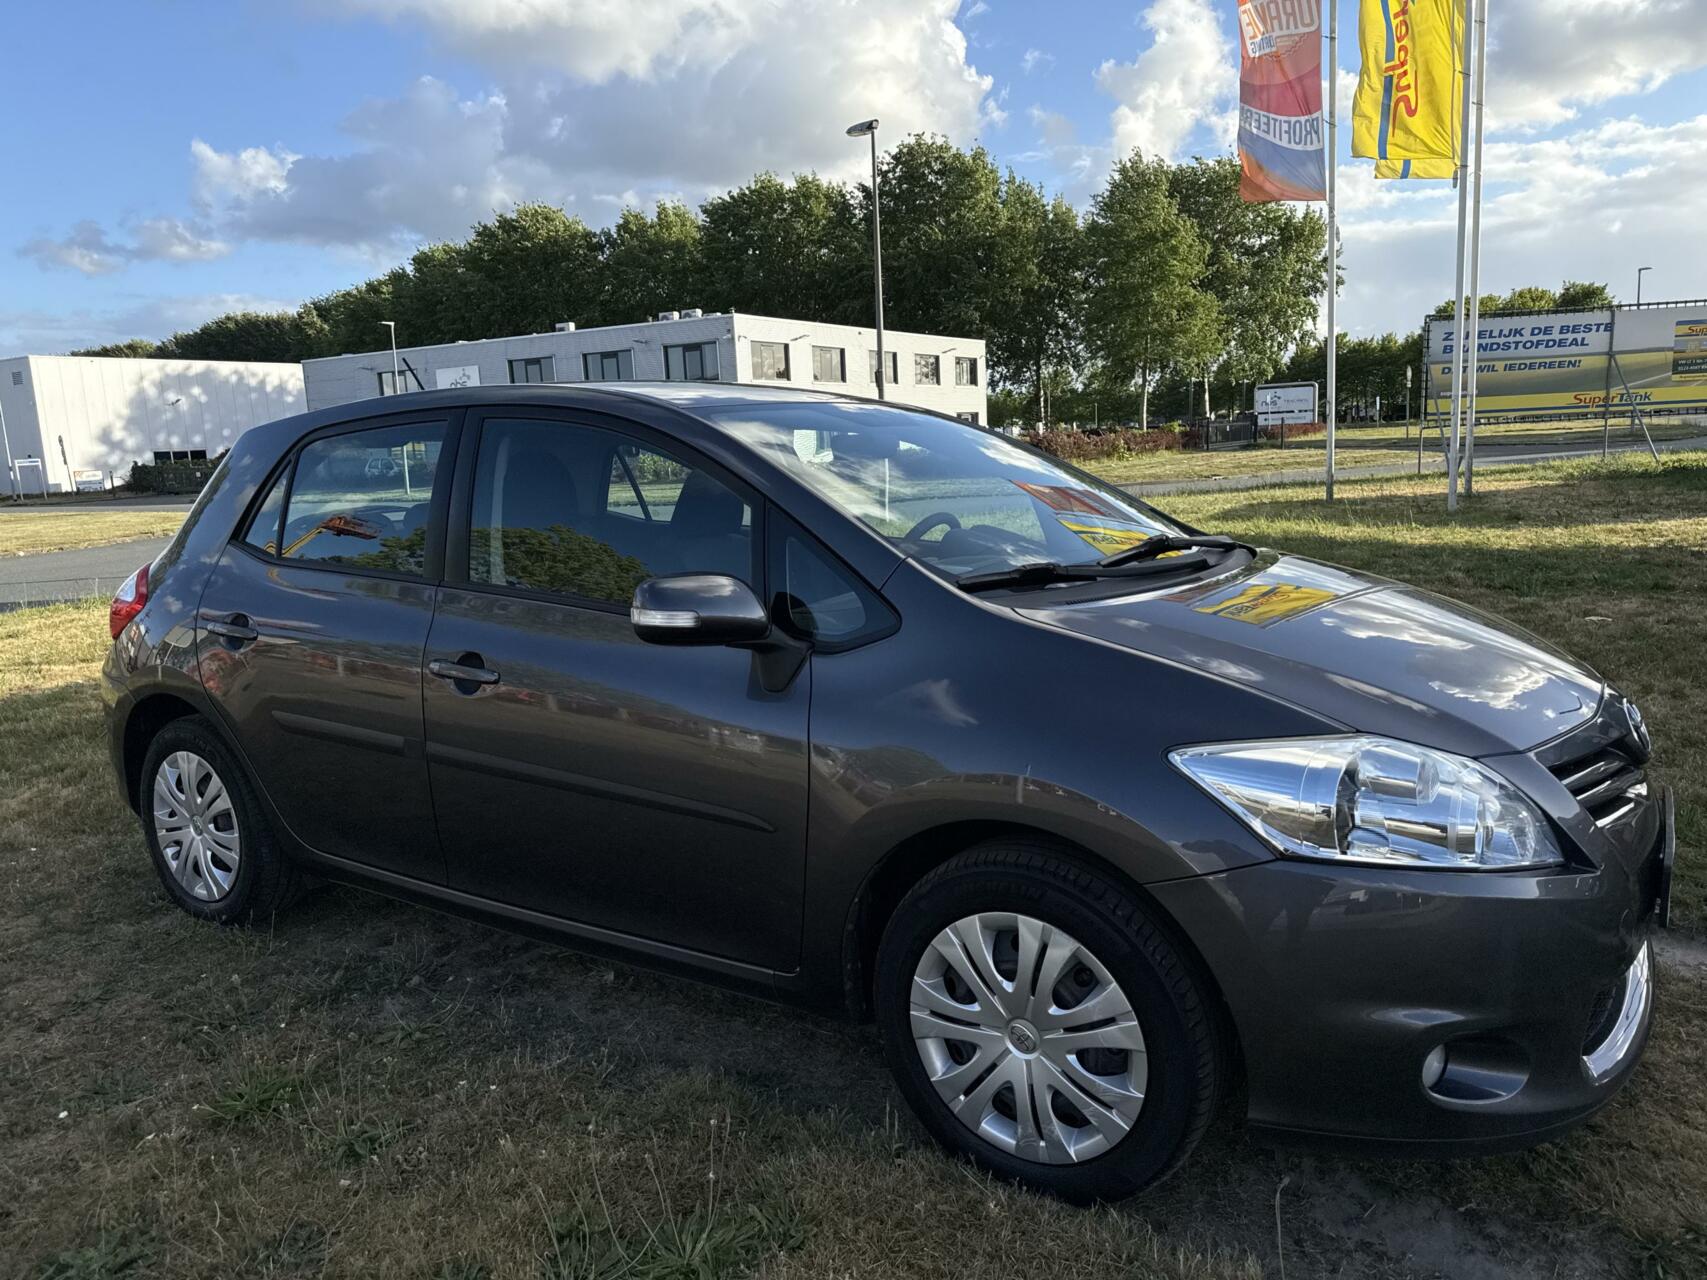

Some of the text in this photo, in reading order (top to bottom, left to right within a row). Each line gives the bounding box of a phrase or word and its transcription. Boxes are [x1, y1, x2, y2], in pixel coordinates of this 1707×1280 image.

[1442, 322, 1613, 341] ZELIJK DE BESTE
[1442, 337, 1589, 354] BNDSTOFDEAL
[1441, 359, 1582, 375] DT WIL IEDEREEN!
